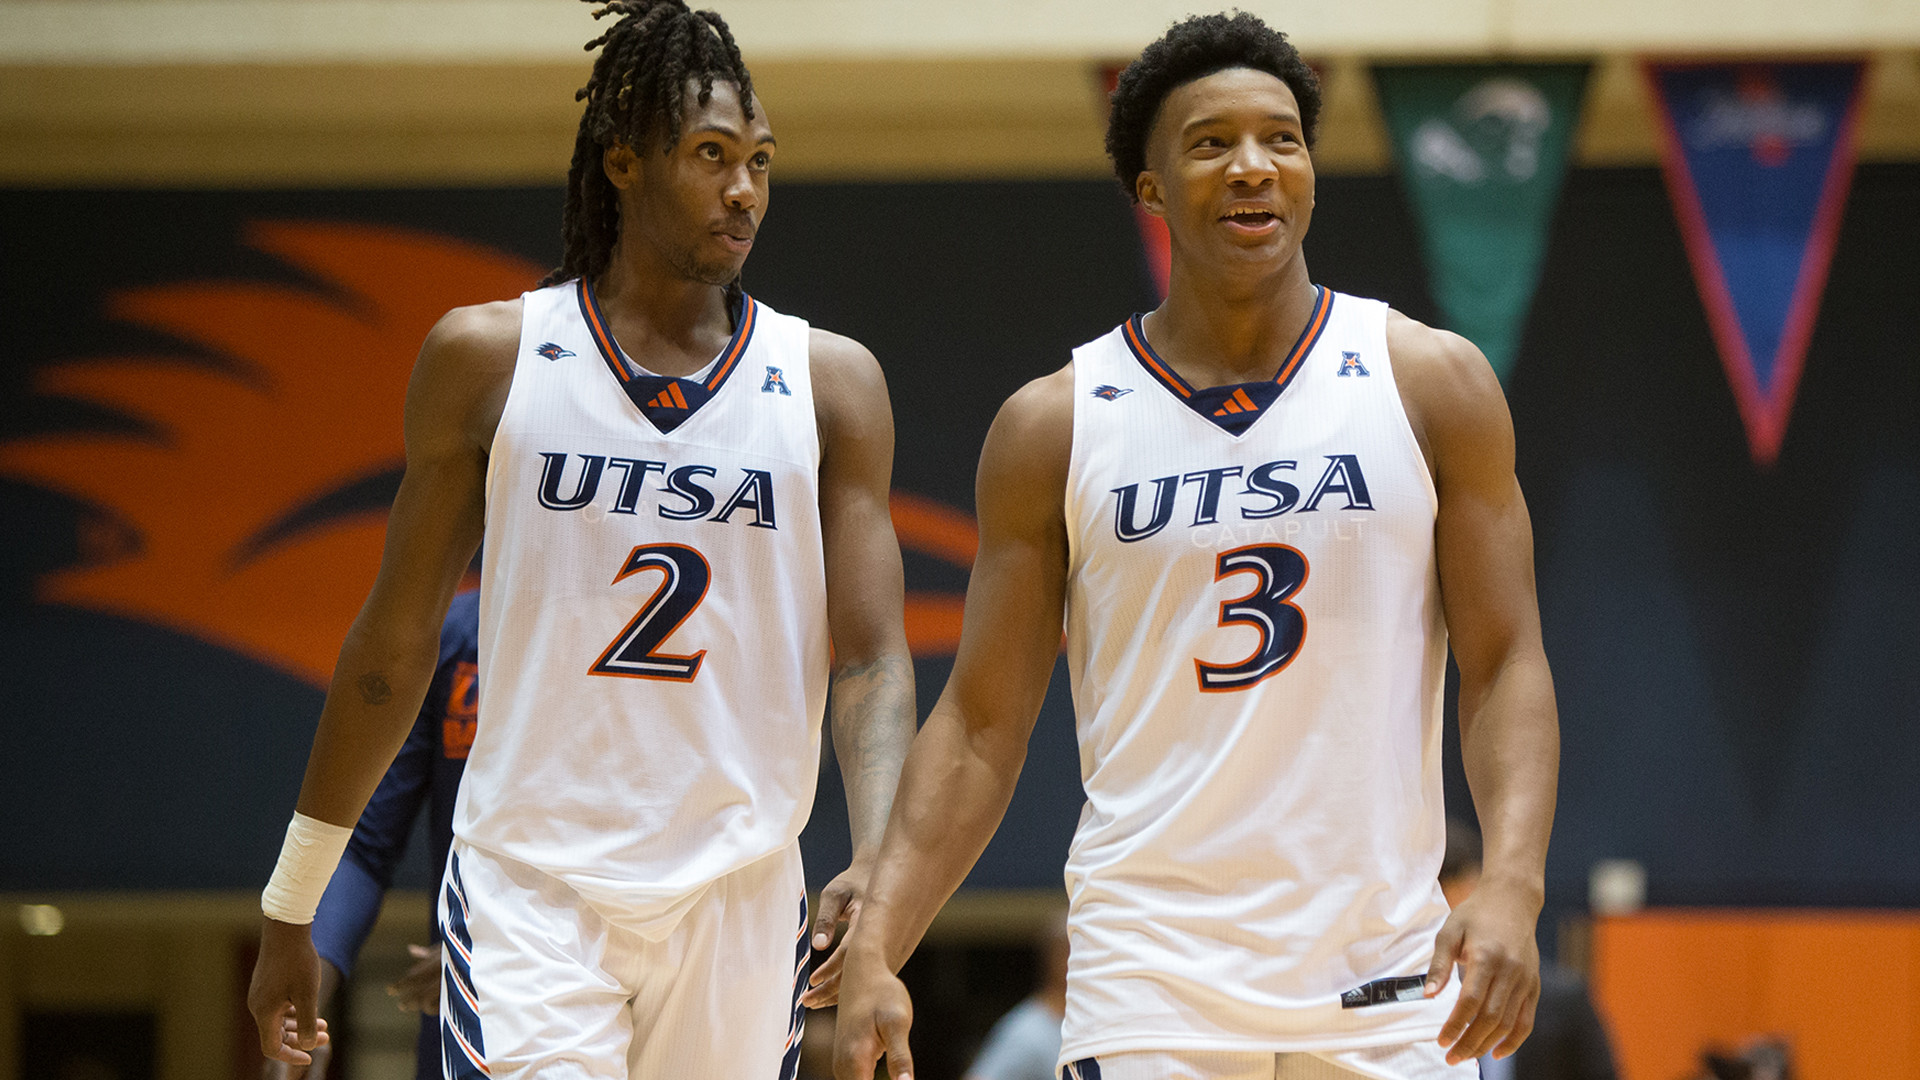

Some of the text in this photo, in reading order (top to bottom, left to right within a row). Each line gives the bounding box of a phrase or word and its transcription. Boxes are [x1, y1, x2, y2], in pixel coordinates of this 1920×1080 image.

[538, 452, 778, 530] UTSA
[1110, 454, 1376, 543] UTSA
[1191, 517, 1368, 549] CATAPULT
[587, 542, 711, 683] 2
[1194, 542, 1310, 693] 3
